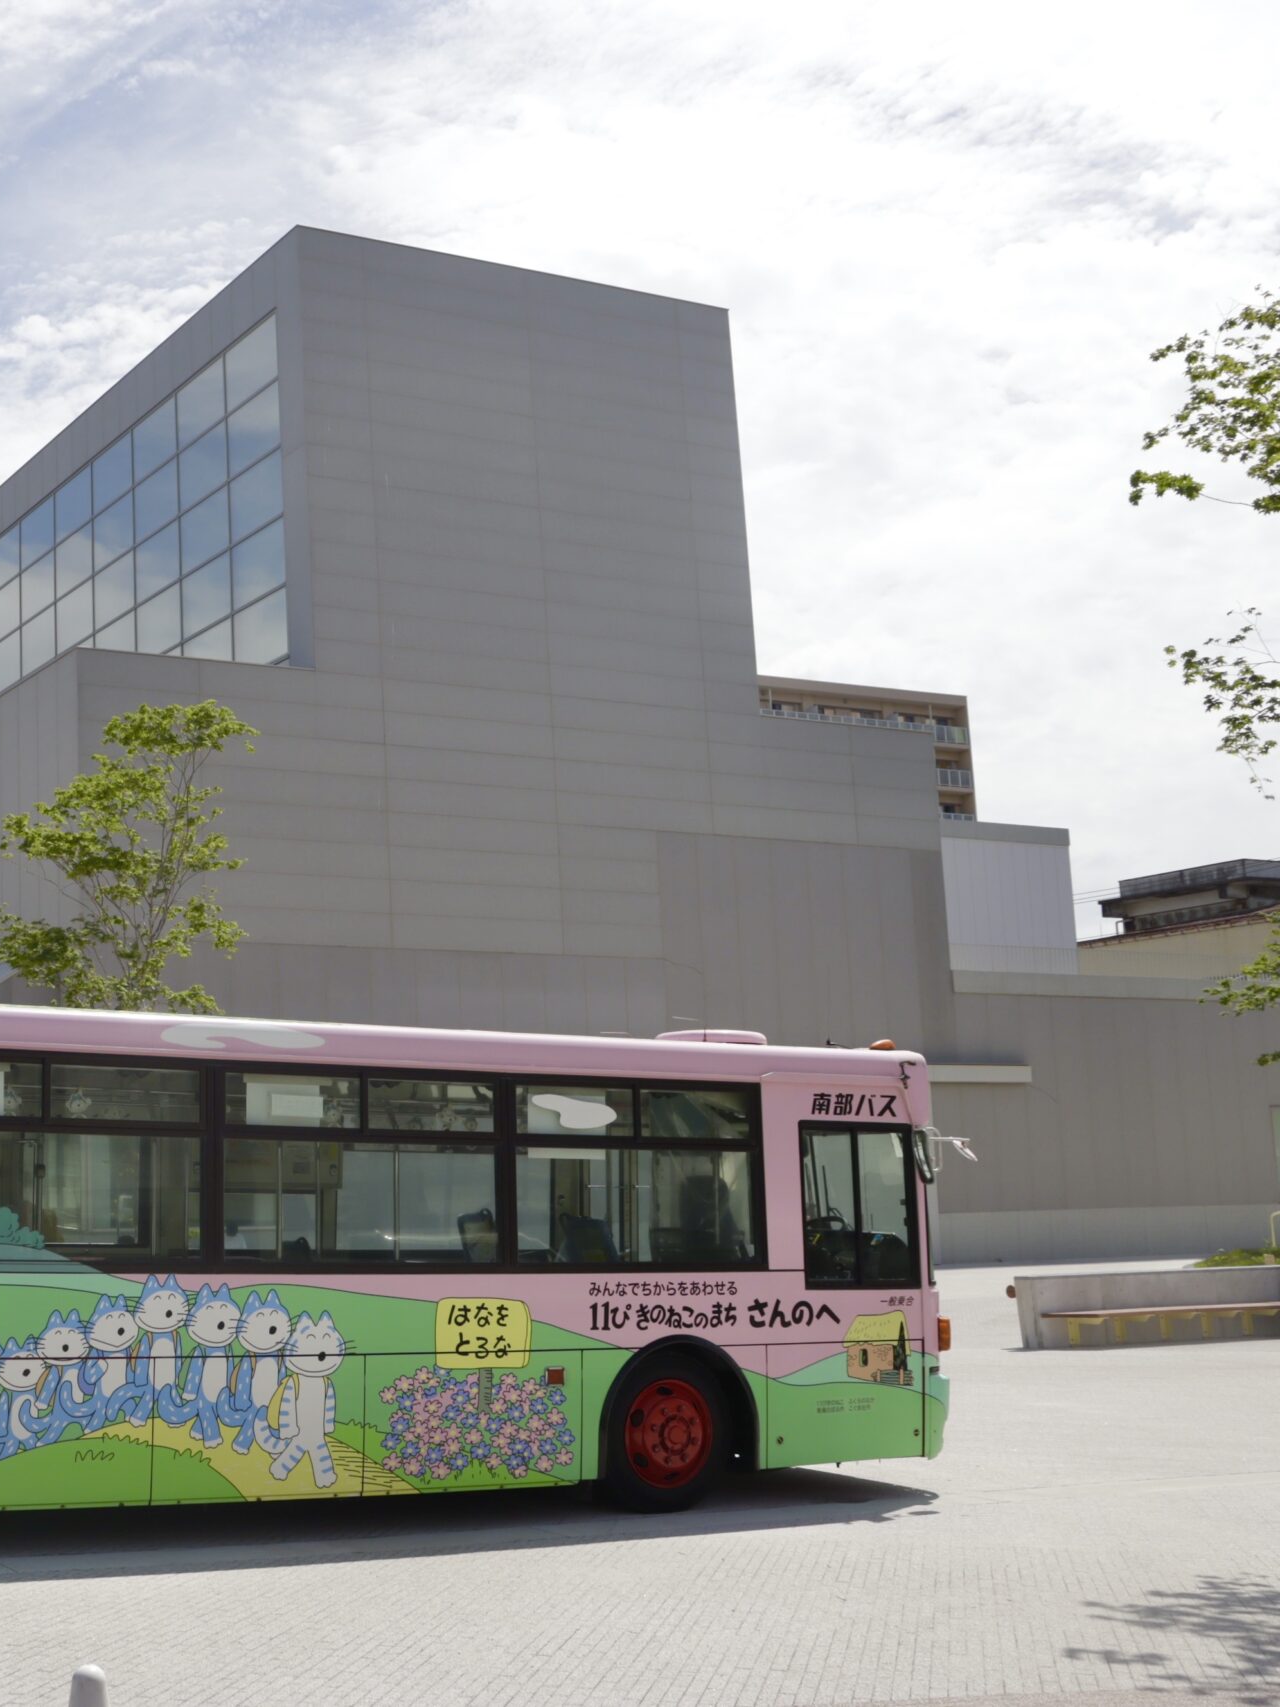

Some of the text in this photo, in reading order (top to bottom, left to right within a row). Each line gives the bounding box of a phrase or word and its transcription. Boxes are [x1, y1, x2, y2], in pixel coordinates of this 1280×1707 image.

[811, 1092, 897, 1117] 南部バス
[588, 1281, 738, 1297] みんなでちからをあわせる
[448, 1303, 509, 1328] はなを
[747, 1298, 841, 1328] さんのへ
[456, 1332, 511, 1359] とるな
